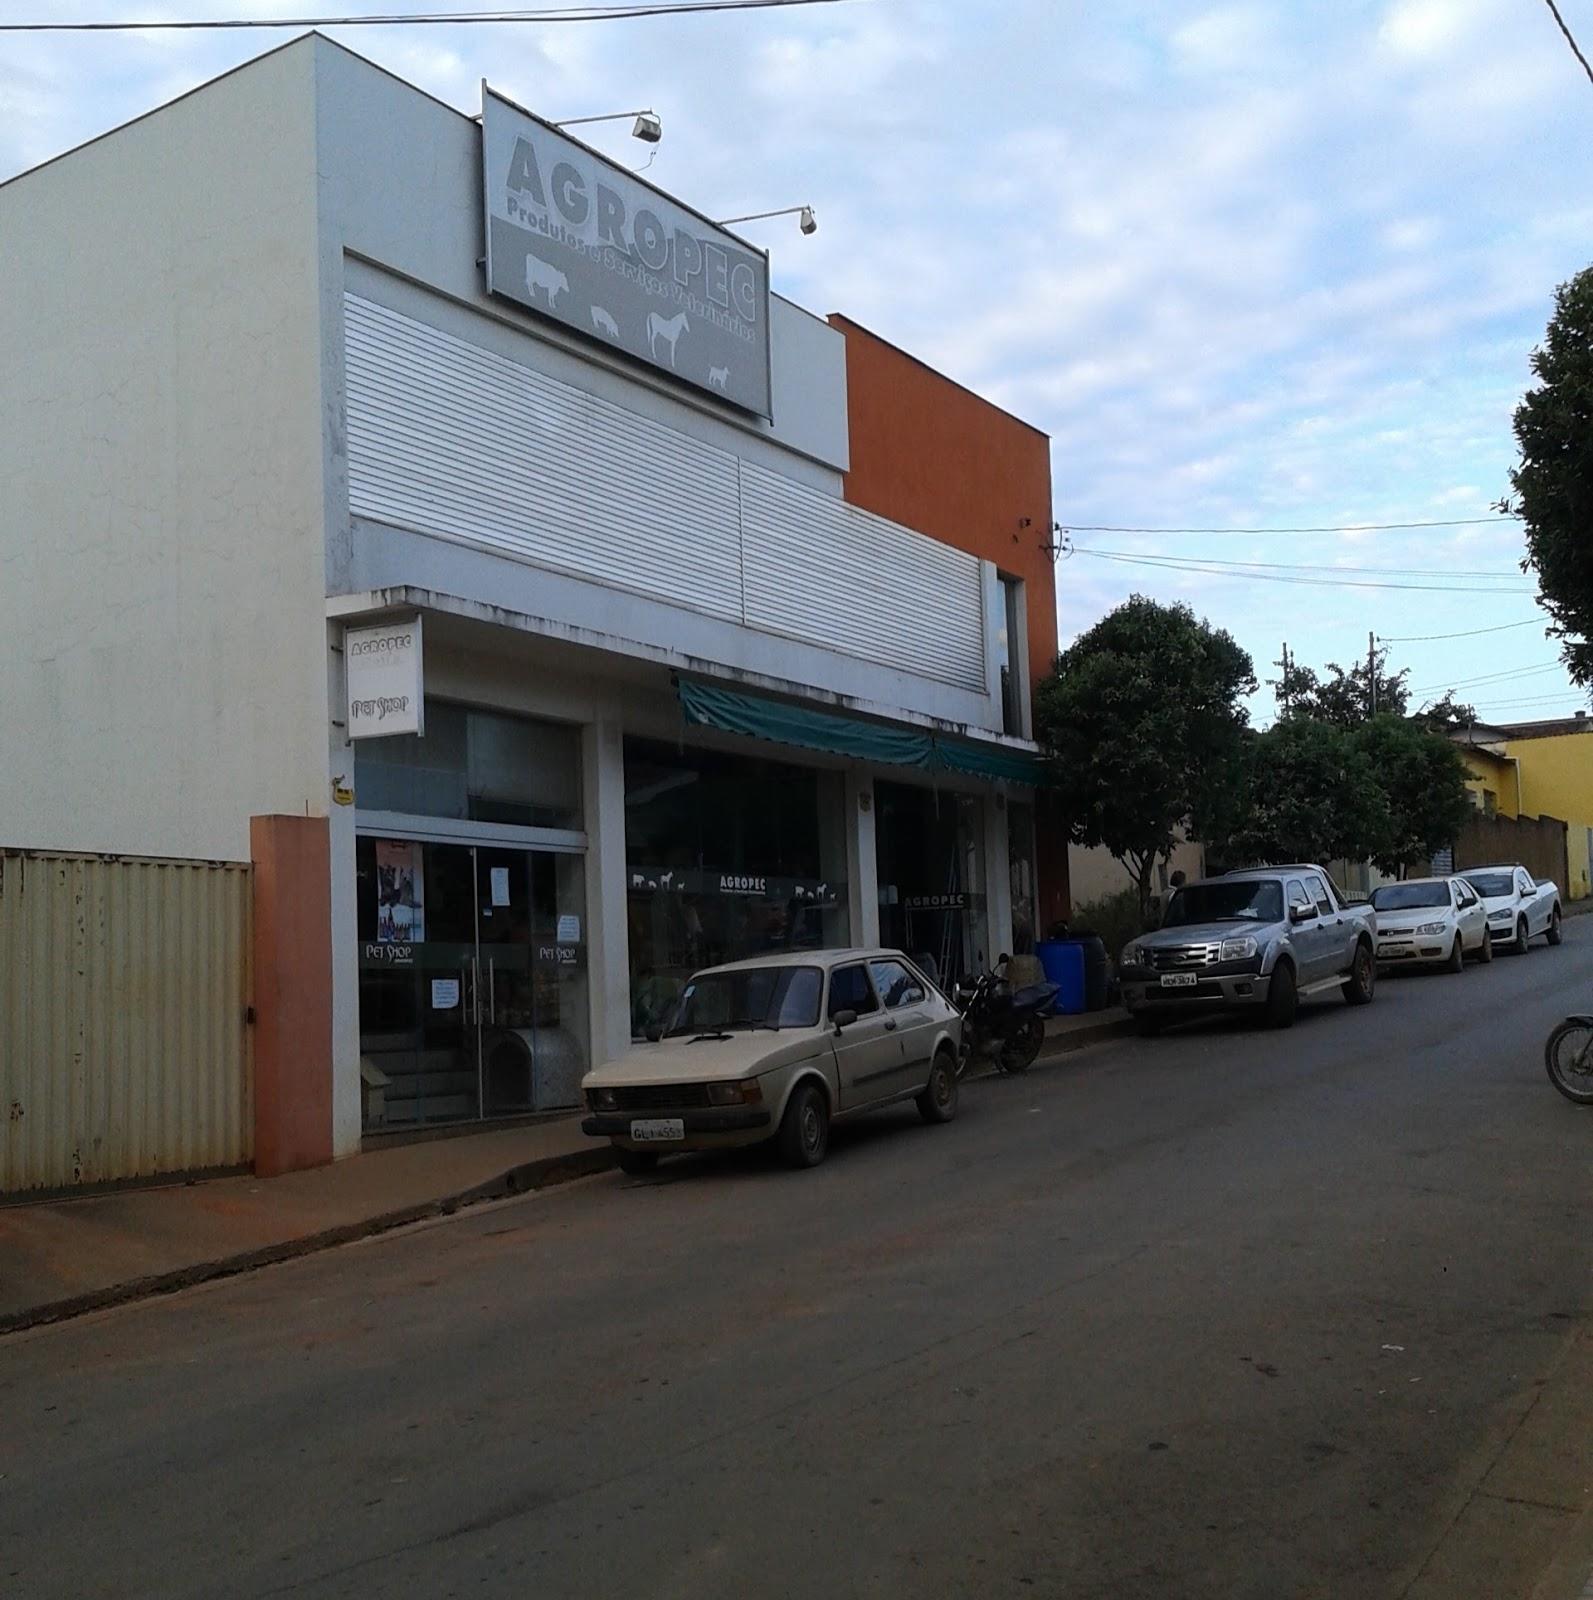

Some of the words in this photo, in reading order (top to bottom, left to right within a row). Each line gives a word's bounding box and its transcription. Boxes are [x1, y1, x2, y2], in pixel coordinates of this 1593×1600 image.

[505, 134, 755, 322] AGROPEC
[507, 196, 586, 254] Produtos
[590, 245, 600, 263] e
[604, 249, 667, 298] Serviços
[670, 283, 755, 341] Veterinários
[351, 634, 412, 656] AGROPEC
[351, 700, 376, 719] PET
[377, 695, 410, 720] SHOP
[720, 875, 766, 890] AGROPEC
[905, 894, 964, 906] AGROPEC
[366, 944, 384, 959] PET
[386, 944, 412, 962] SHOP
[539, 946, 554, 960] PET
[555, 946, 576, 962] SHOP
